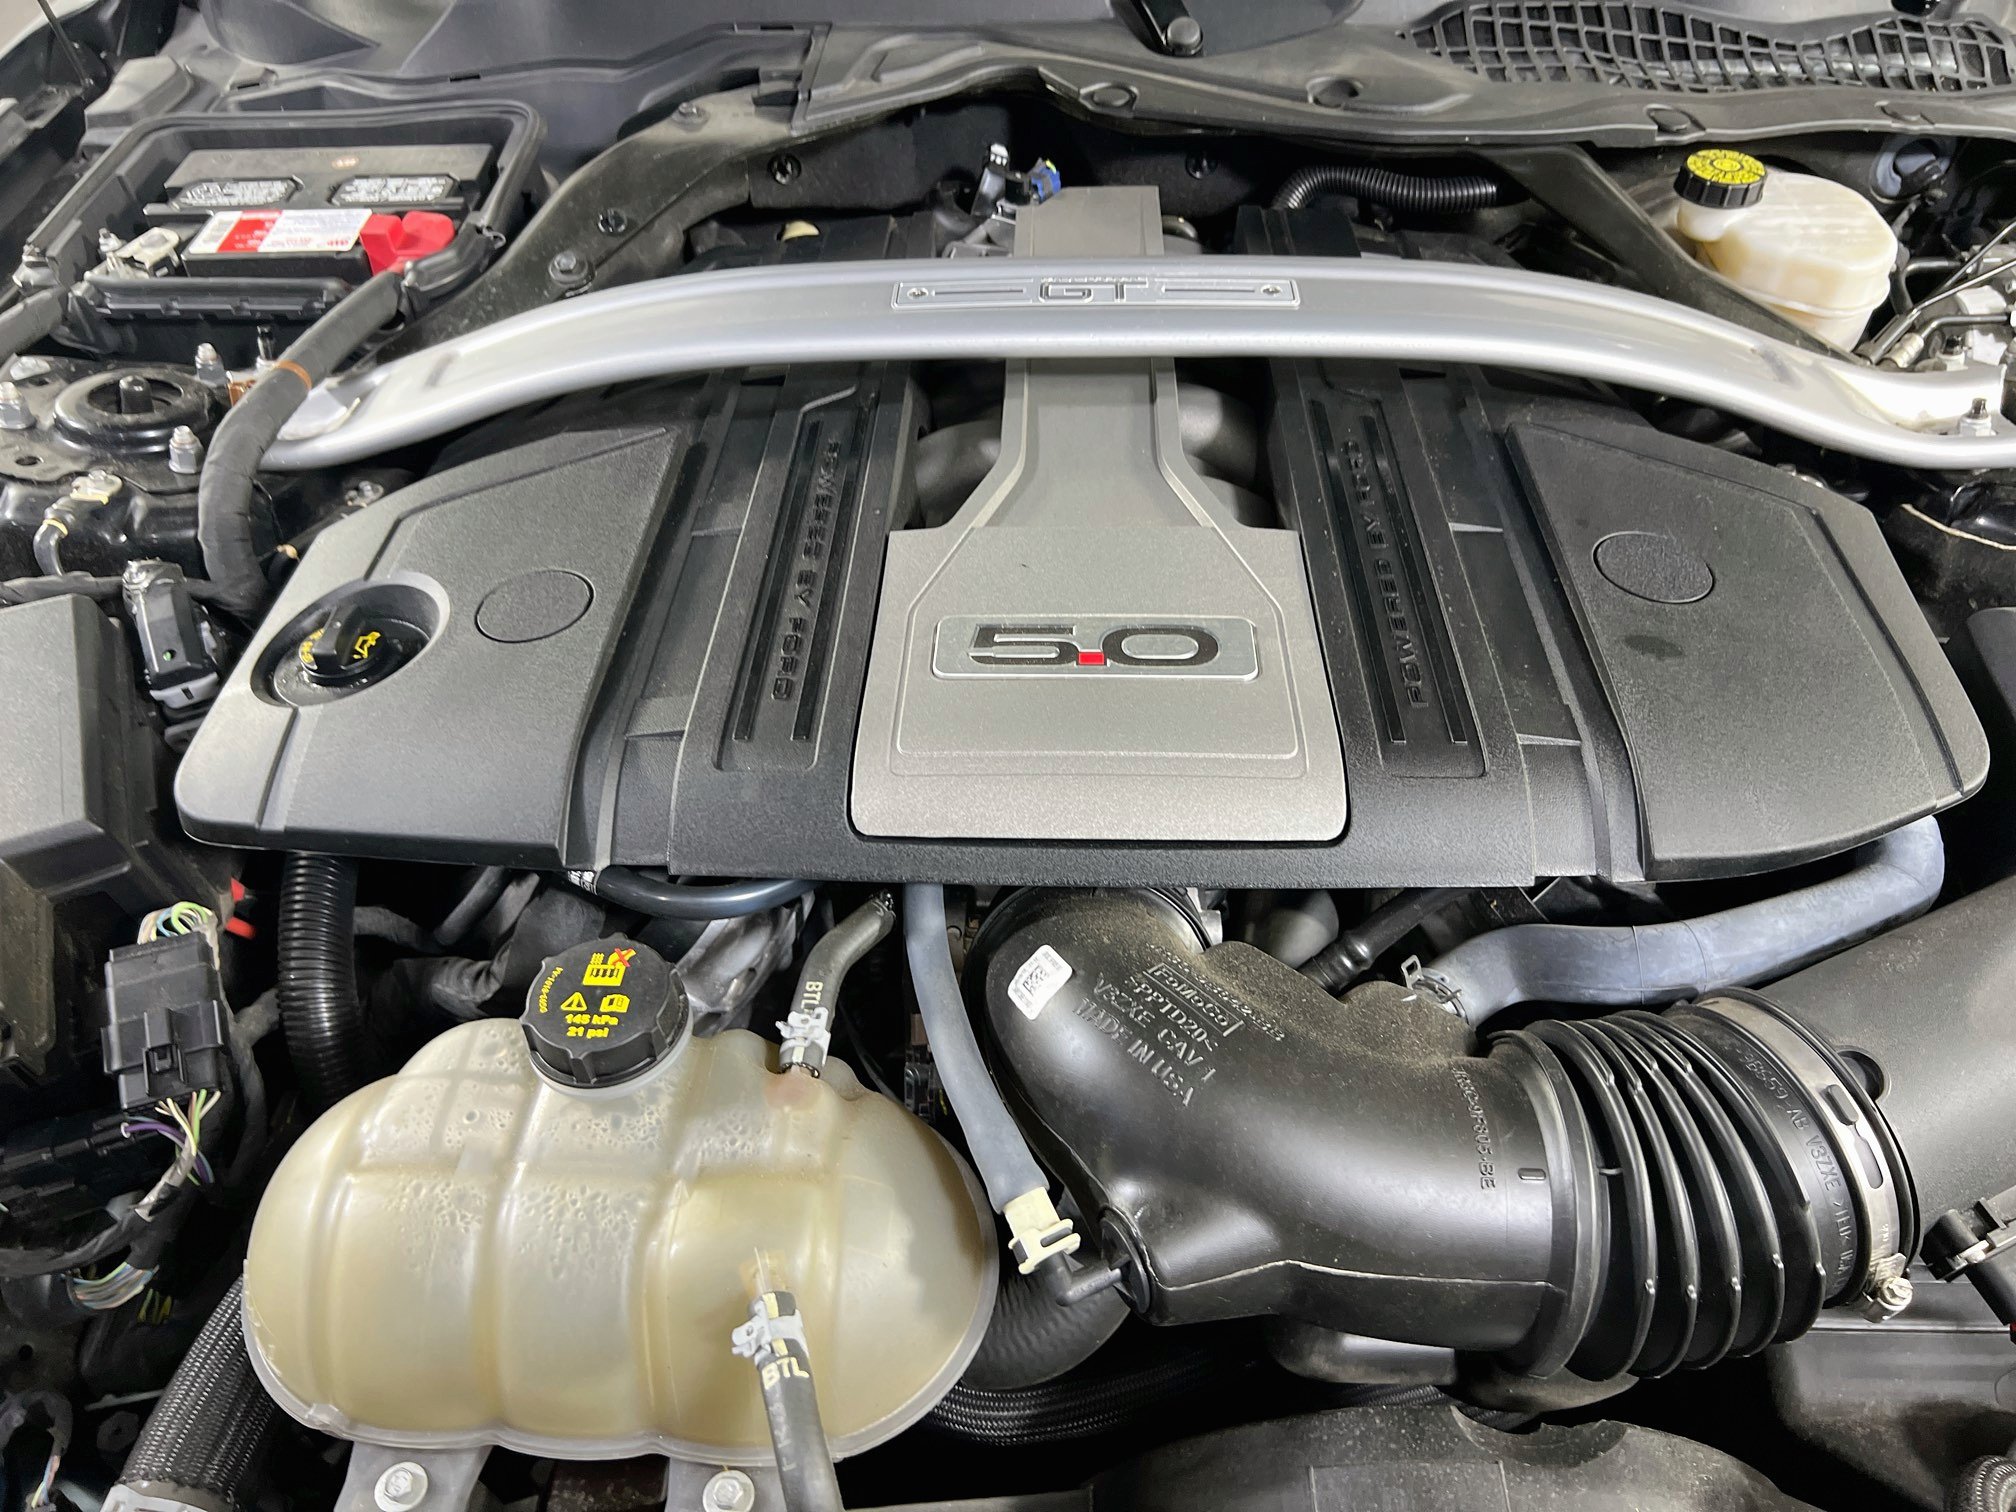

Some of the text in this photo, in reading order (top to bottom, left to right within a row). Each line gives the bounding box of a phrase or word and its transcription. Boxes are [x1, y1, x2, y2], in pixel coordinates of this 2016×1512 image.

[1039, 279, 1149, 303] GT
[1361, 514, 1389, 549] BY
[795, 570, 818, 609] BY
[967, 623, 1220, 667] 5.0
[1373, 558, 1430, 709] POWERED
[770, 616, 806, 701] FORD
[1152, 965, 1230, 1028] FoMoCo
[565, 1013, 591, 1025] 145
[566, 1026, 585, 1038] 21
[1127, 1038, 1156, 1065] IN
[1157, 1028, 1204, 1067] CAV
[761, 1355, 811, 1390] BTL
